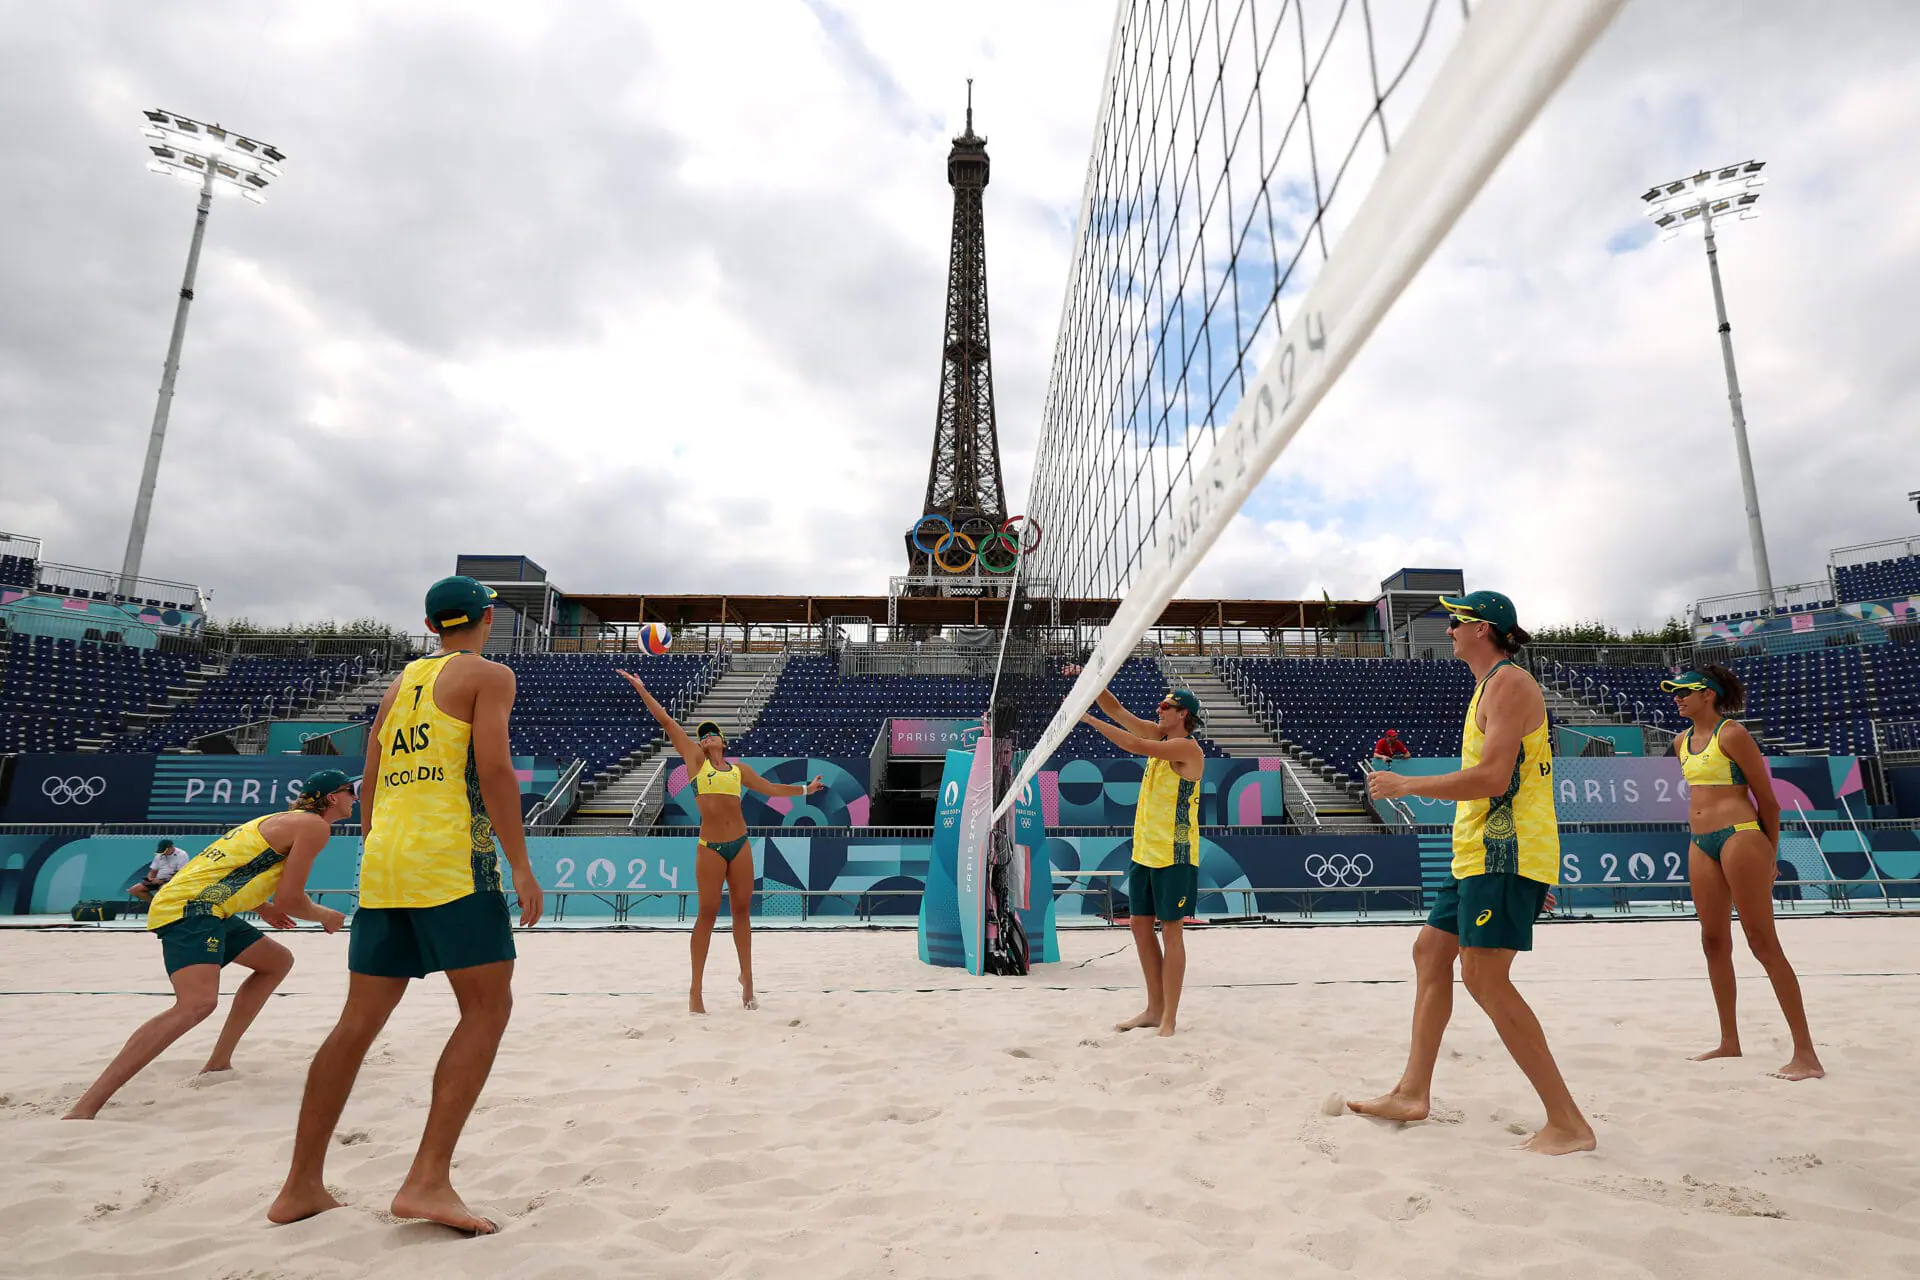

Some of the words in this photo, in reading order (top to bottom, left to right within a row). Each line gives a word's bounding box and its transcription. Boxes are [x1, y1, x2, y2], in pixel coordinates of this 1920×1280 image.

[413, 685, 424, 711] 1
[898, 732, 936, 742] PARIS
[940, 732, 975, 742] 2024
[554, 857, 678, 889] 2024
[966, 845, 974, 893] PARIS
[1599, 852, 1685, 882] 202
